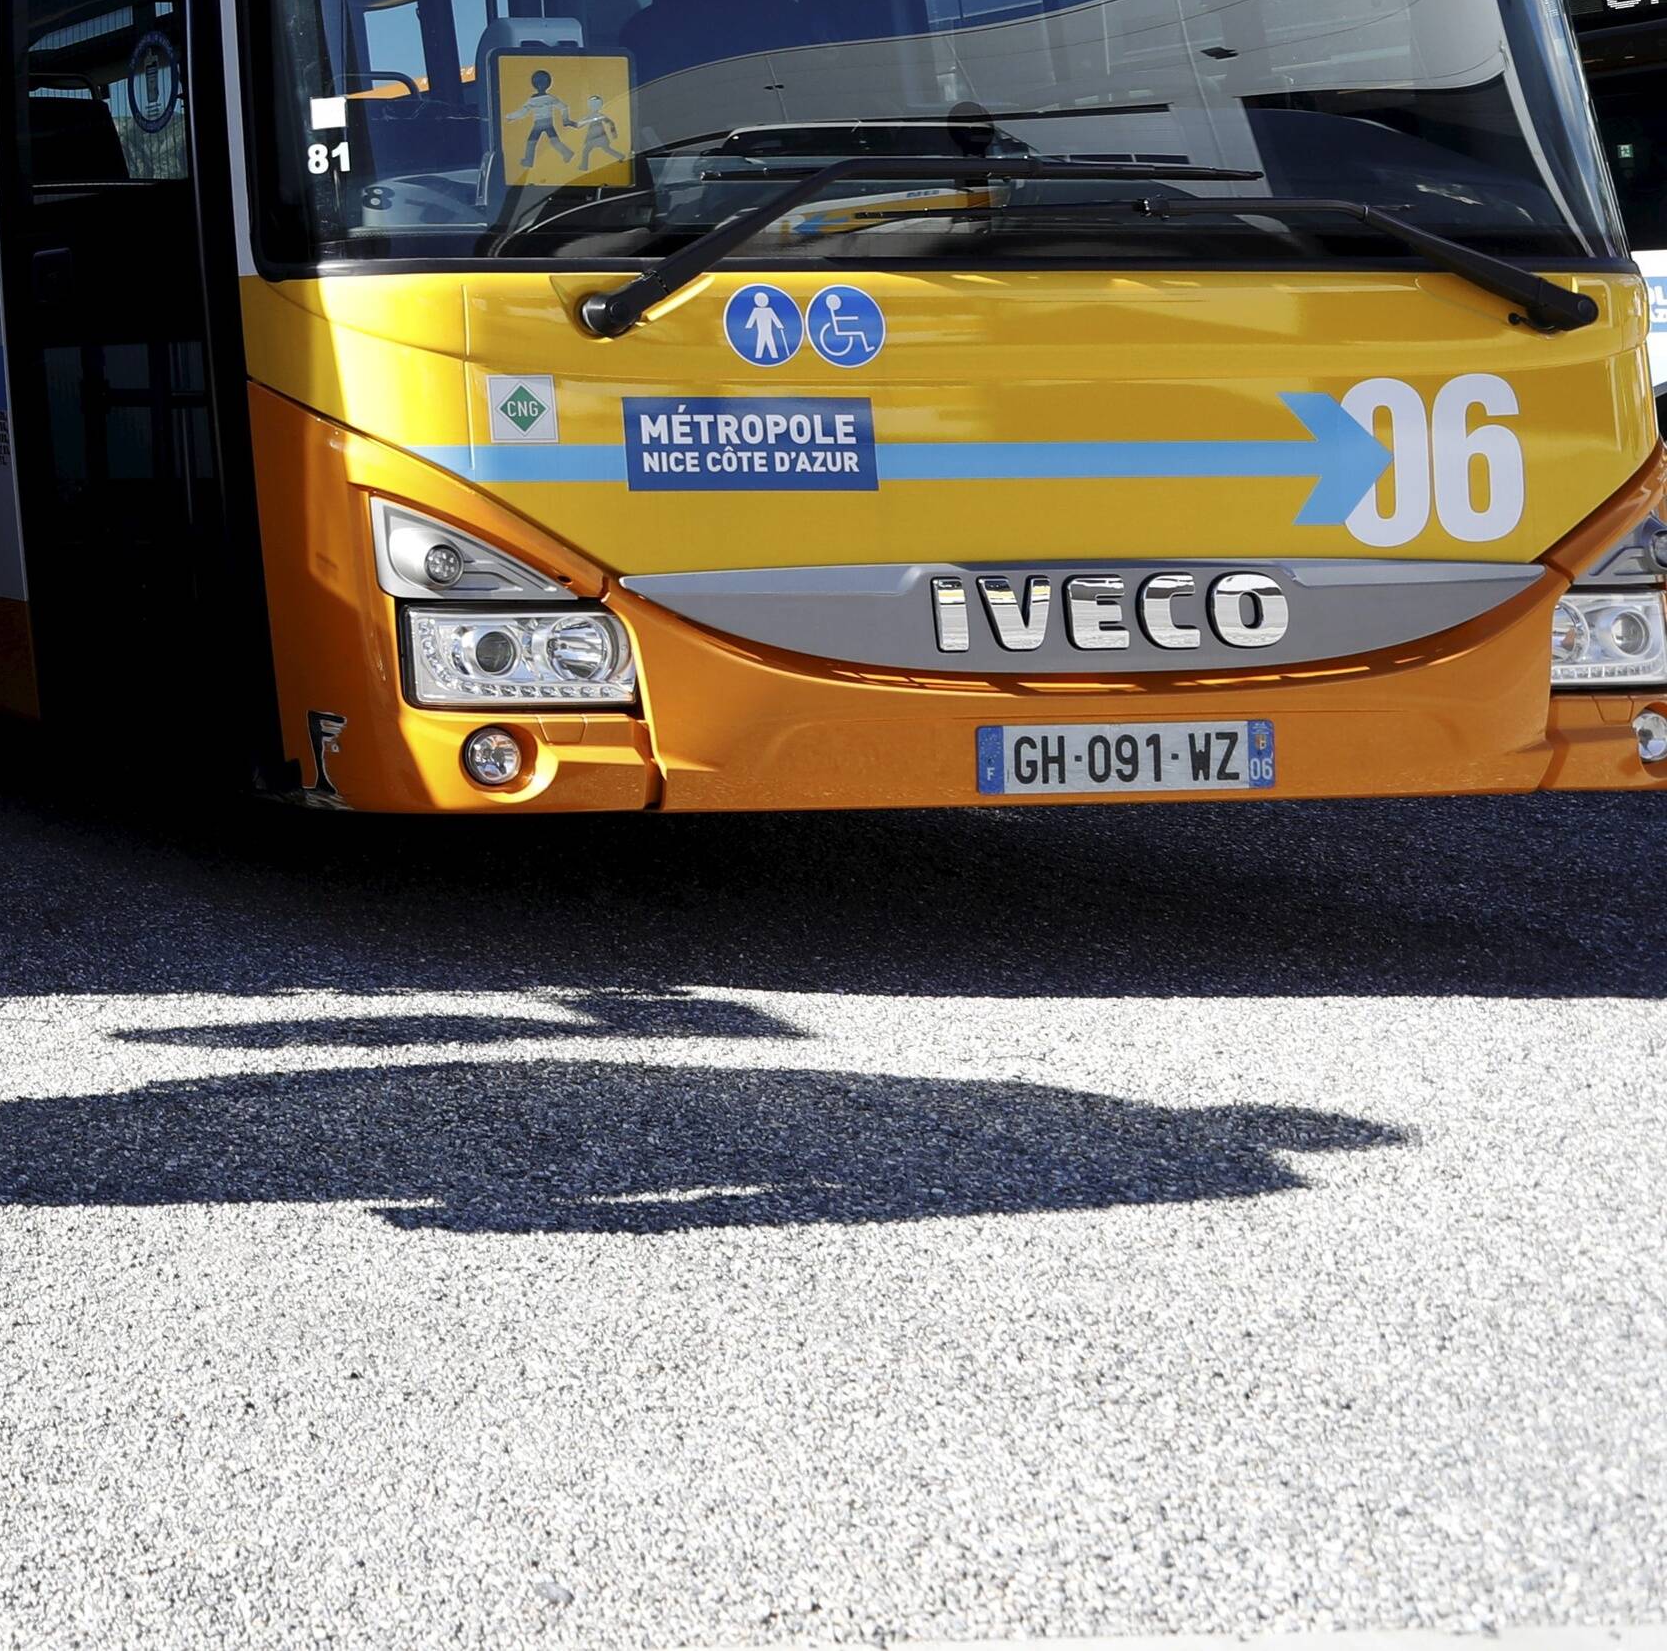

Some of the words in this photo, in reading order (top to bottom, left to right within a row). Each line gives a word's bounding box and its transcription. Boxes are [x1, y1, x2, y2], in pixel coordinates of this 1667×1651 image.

[308, 141, 351, 175] 81
[507, 400, 539, 418] CNG
[640, 405, 857, 445] MÉTROPOLE
[643, 452, 700, 472] NICE
[707, 446, 768, 472] CÔTE
[776, 451, 859, 472] D'AZUR
[1340, 373, 1524, 548] 06
[930, 572, 1290, 654] IVECO
[986, 767, 995, 781] F
[1014, 732, 1240, 784] GH-091-WZ
[1249, 758, 1273, 780] 06
